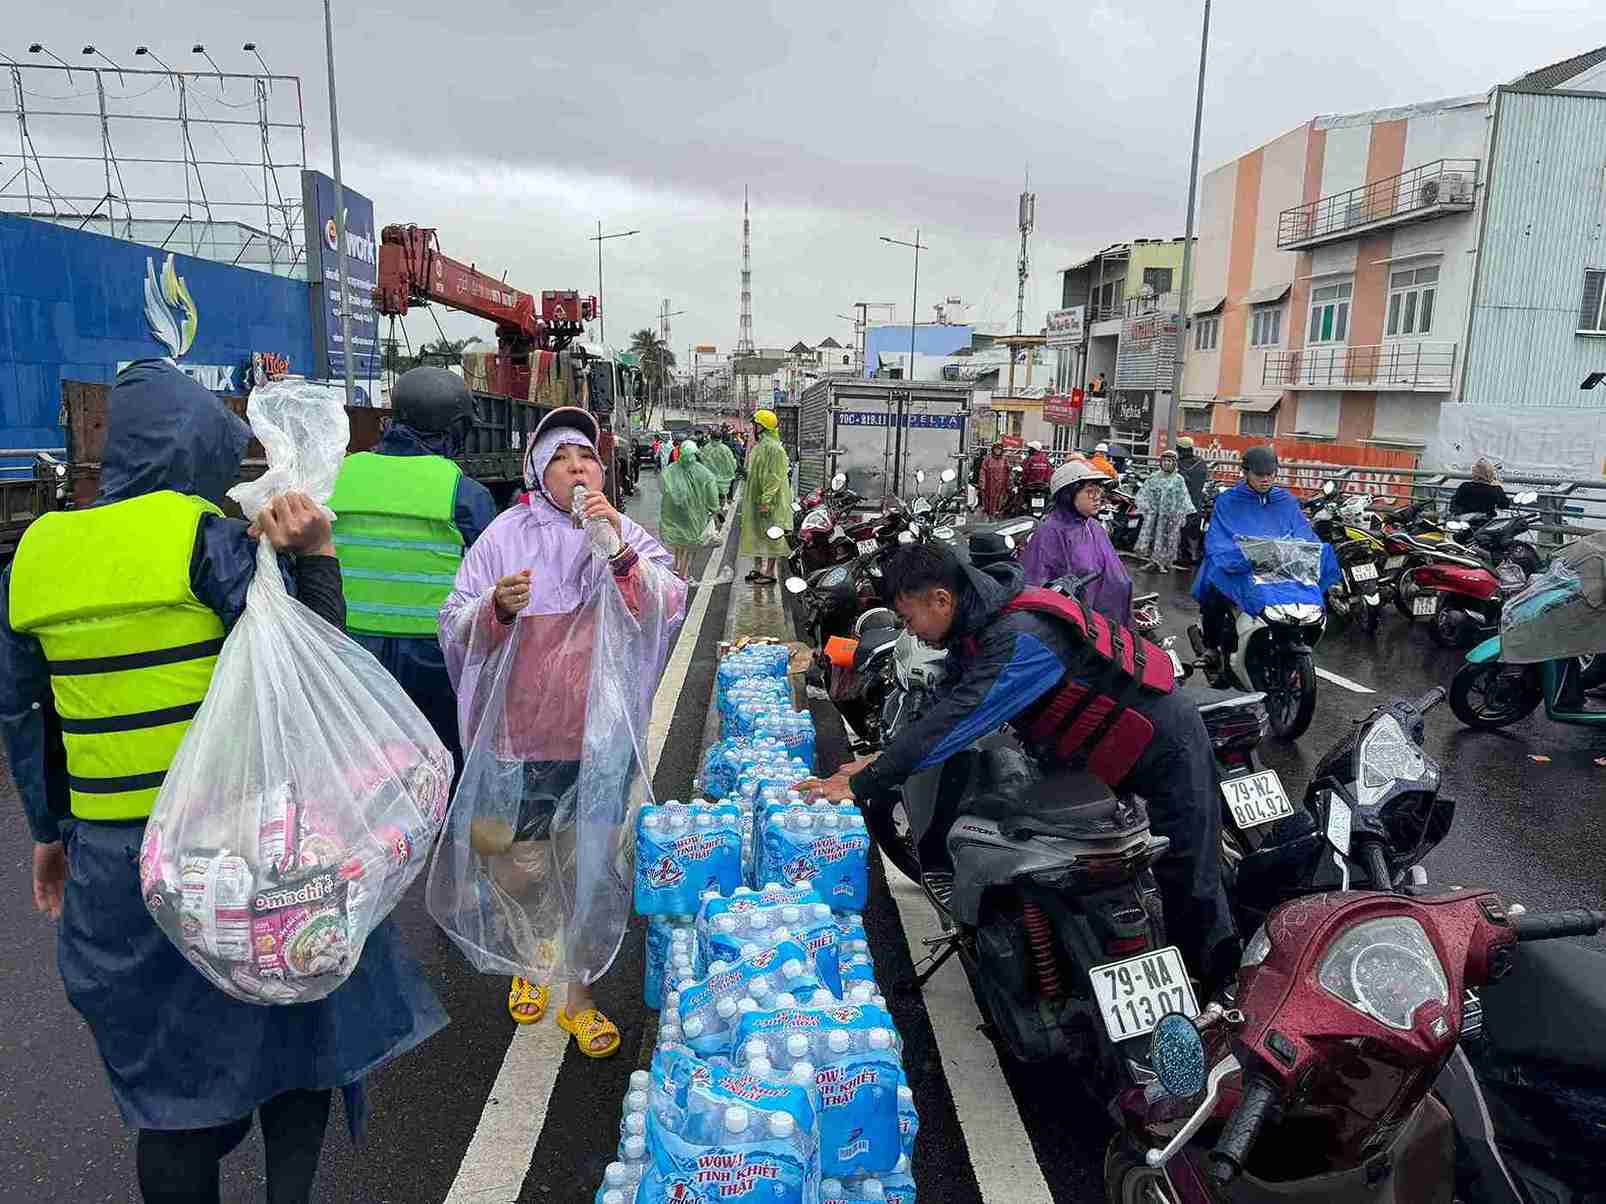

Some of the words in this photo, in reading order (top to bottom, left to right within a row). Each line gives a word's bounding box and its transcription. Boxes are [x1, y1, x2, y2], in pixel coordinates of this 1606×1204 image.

[1230, 776, 1274, 802] 79-NZ
[1234, 796, 1289, 824] 804.92
[1104, 954, 1174, 1000] 79-NA
[698, 1152, 743, 1169] WOW!
